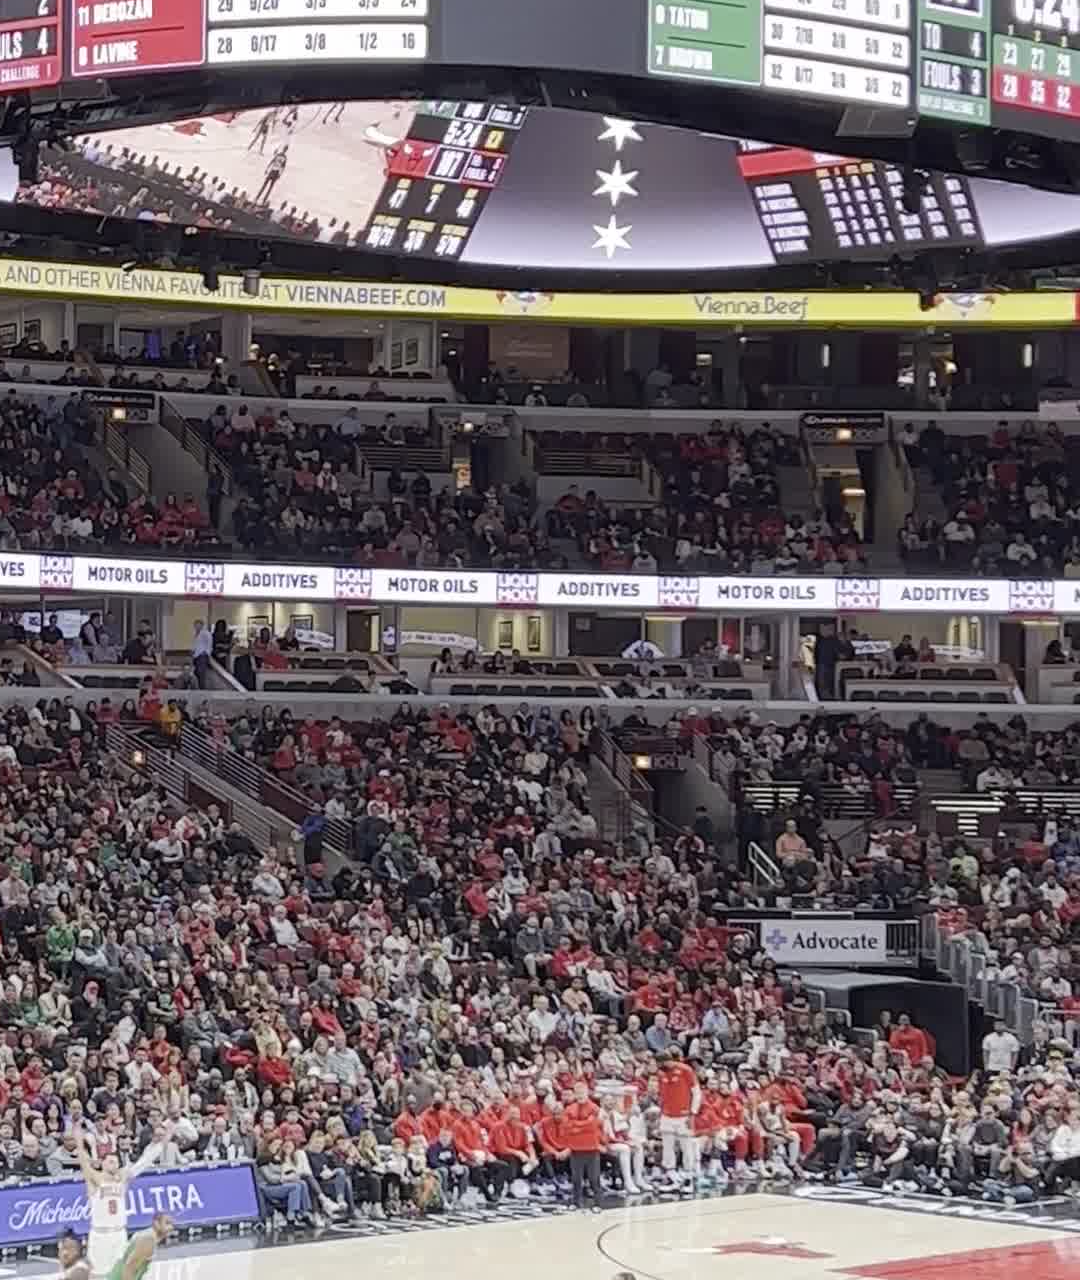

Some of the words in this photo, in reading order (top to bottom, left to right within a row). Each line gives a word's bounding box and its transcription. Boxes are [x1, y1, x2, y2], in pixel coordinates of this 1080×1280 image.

[37, 27, 48, 54] 4
[216, 36, 233, 55] 28
[359, 31, 378, 50] 1/2
[924, 22, 941, 50] TO
[923, 59, 962, 92] FOULS
[971, 68, 981, 96] 3
[5, 267, 39, 285] AND
[47, 269, 101, 289] OTHER
[105, 272, 167, 295] VIENNA
[262, 283, 281, 301] AT
[286, 285, 445, 308] VIENNABEEF.COM
[694, 296, 759, 317] Vienna
[763, 294, 808, 320] Beef
[88, 566, 133, 583] MOTOR
[135, 568, 169, 585] OILS
[241, 572, 318, 589] ADDITIVES
[388, 577, 438, 593] MOTOR
[443, 579, 479, 594] OILS
[558, 583, 641, 597] ADDITIVES
[717, 585, 775, 600] MOTOR
[779, 585, 816, 600] OILS
[900, 587, 990, 602] ADDITIVES
[792, 932, 878, 951] Advocate
